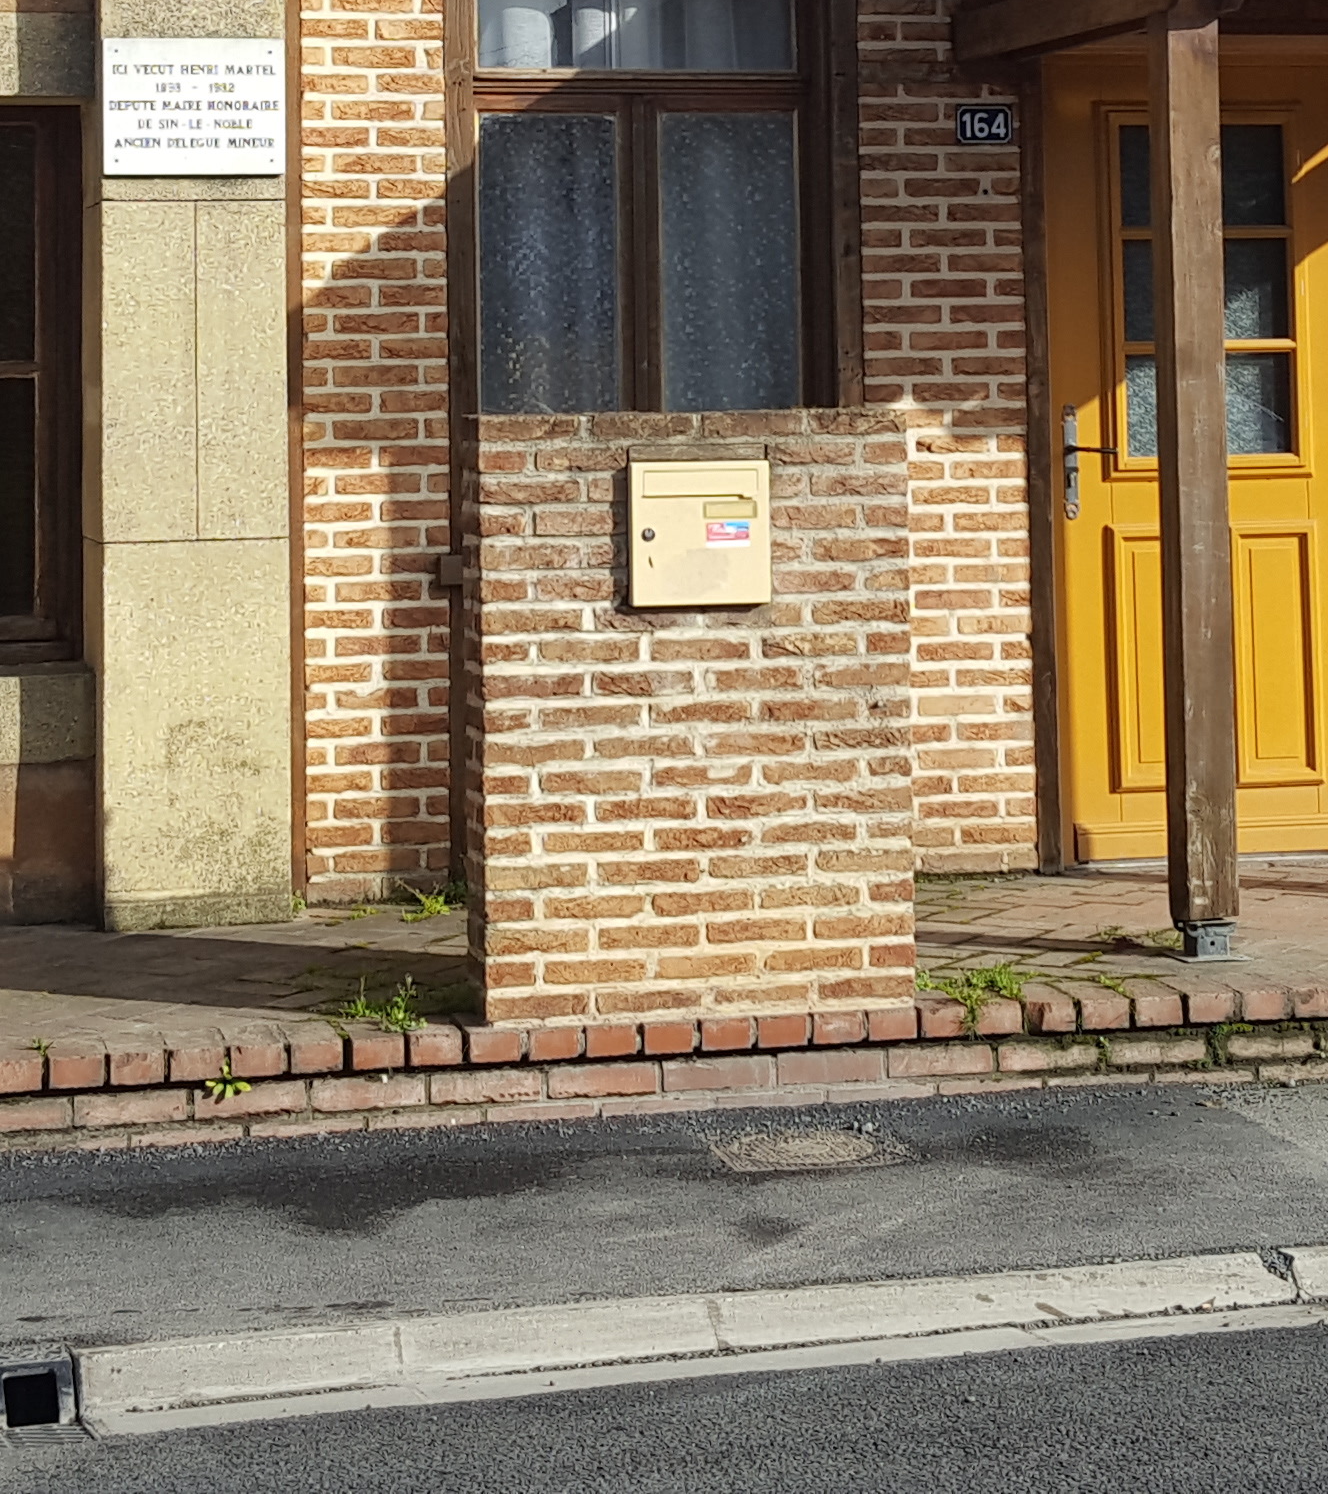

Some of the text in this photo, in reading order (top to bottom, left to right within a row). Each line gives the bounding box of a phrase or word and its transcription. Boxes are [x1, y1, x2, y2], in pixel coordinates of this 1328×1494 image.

[112, 64, 276, 75] ICI VECUT HENRI MARTEL
[109, 100, 279, 111] DEPUTE MAIRE HONORAIRE
[138, 119, 152, 129] DE
[961, 112, 1007, 139] 164
[114, 138, 275, 148] ANCIEN DELEGUE MINEUR
